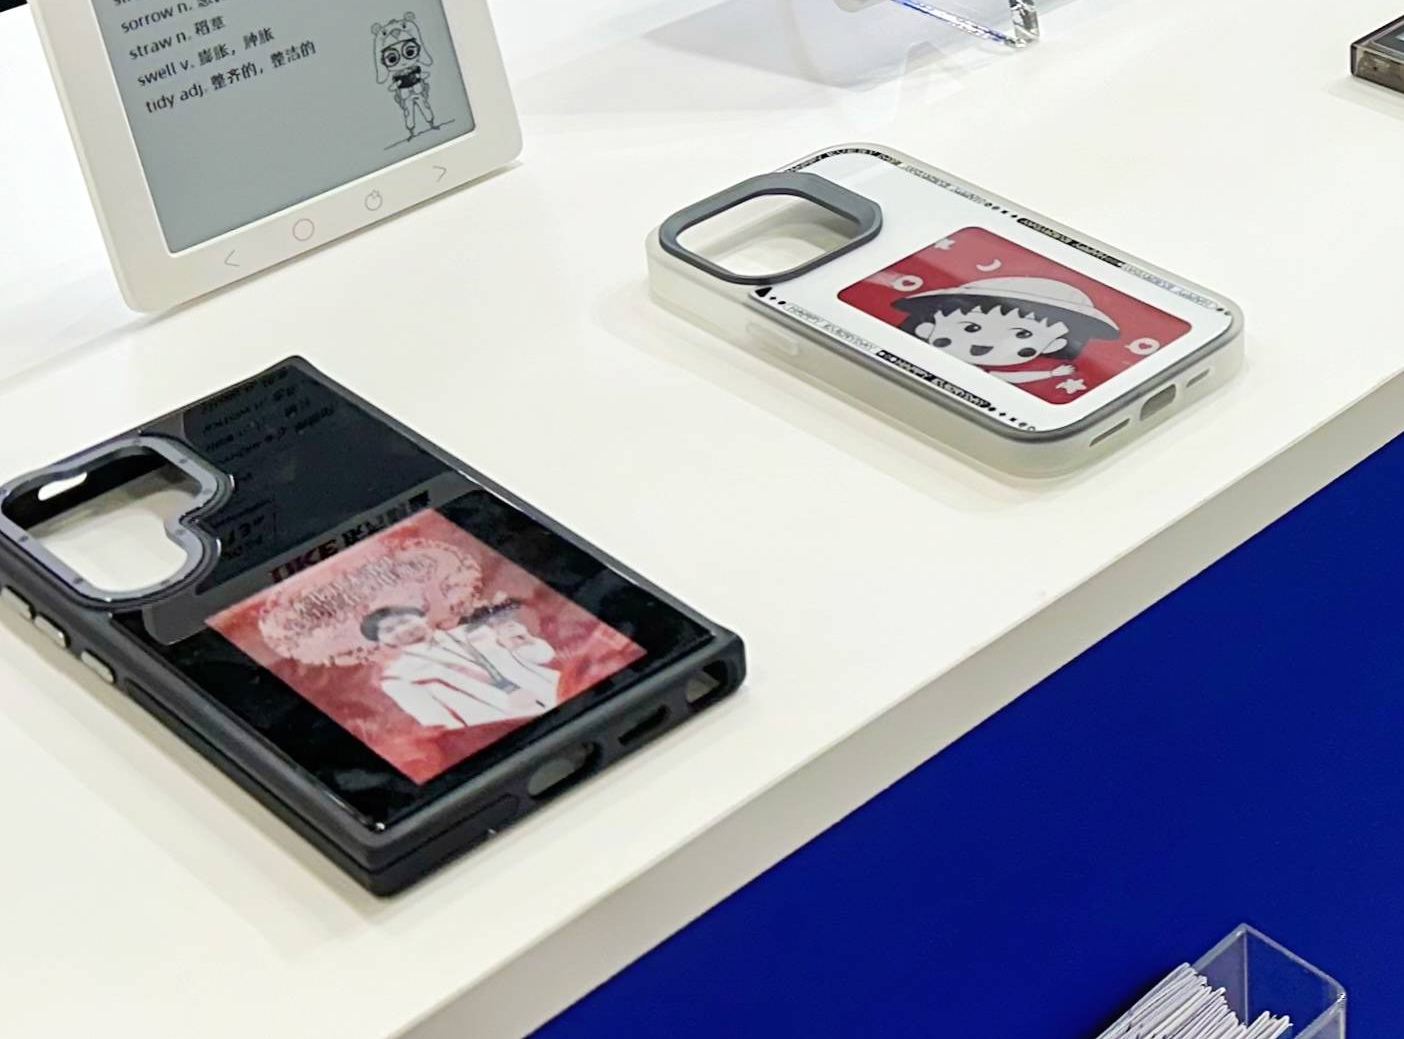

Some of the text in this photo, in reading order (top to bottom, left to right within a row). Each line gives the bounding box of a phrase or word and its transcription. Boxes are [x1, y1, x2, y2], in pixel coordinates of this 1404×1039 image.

[121, 6, 174, 33] sorrow
[177, 2, 193, 14] n.
[129, 35, 172, 60] straw
[176, 31, 192, 44] n.
[137, 62, 177, 87] swell
[179, 59, 195, 72] v.
[146, 93, 175, 113] tidy
[180, 83, 208, 102] adj.
